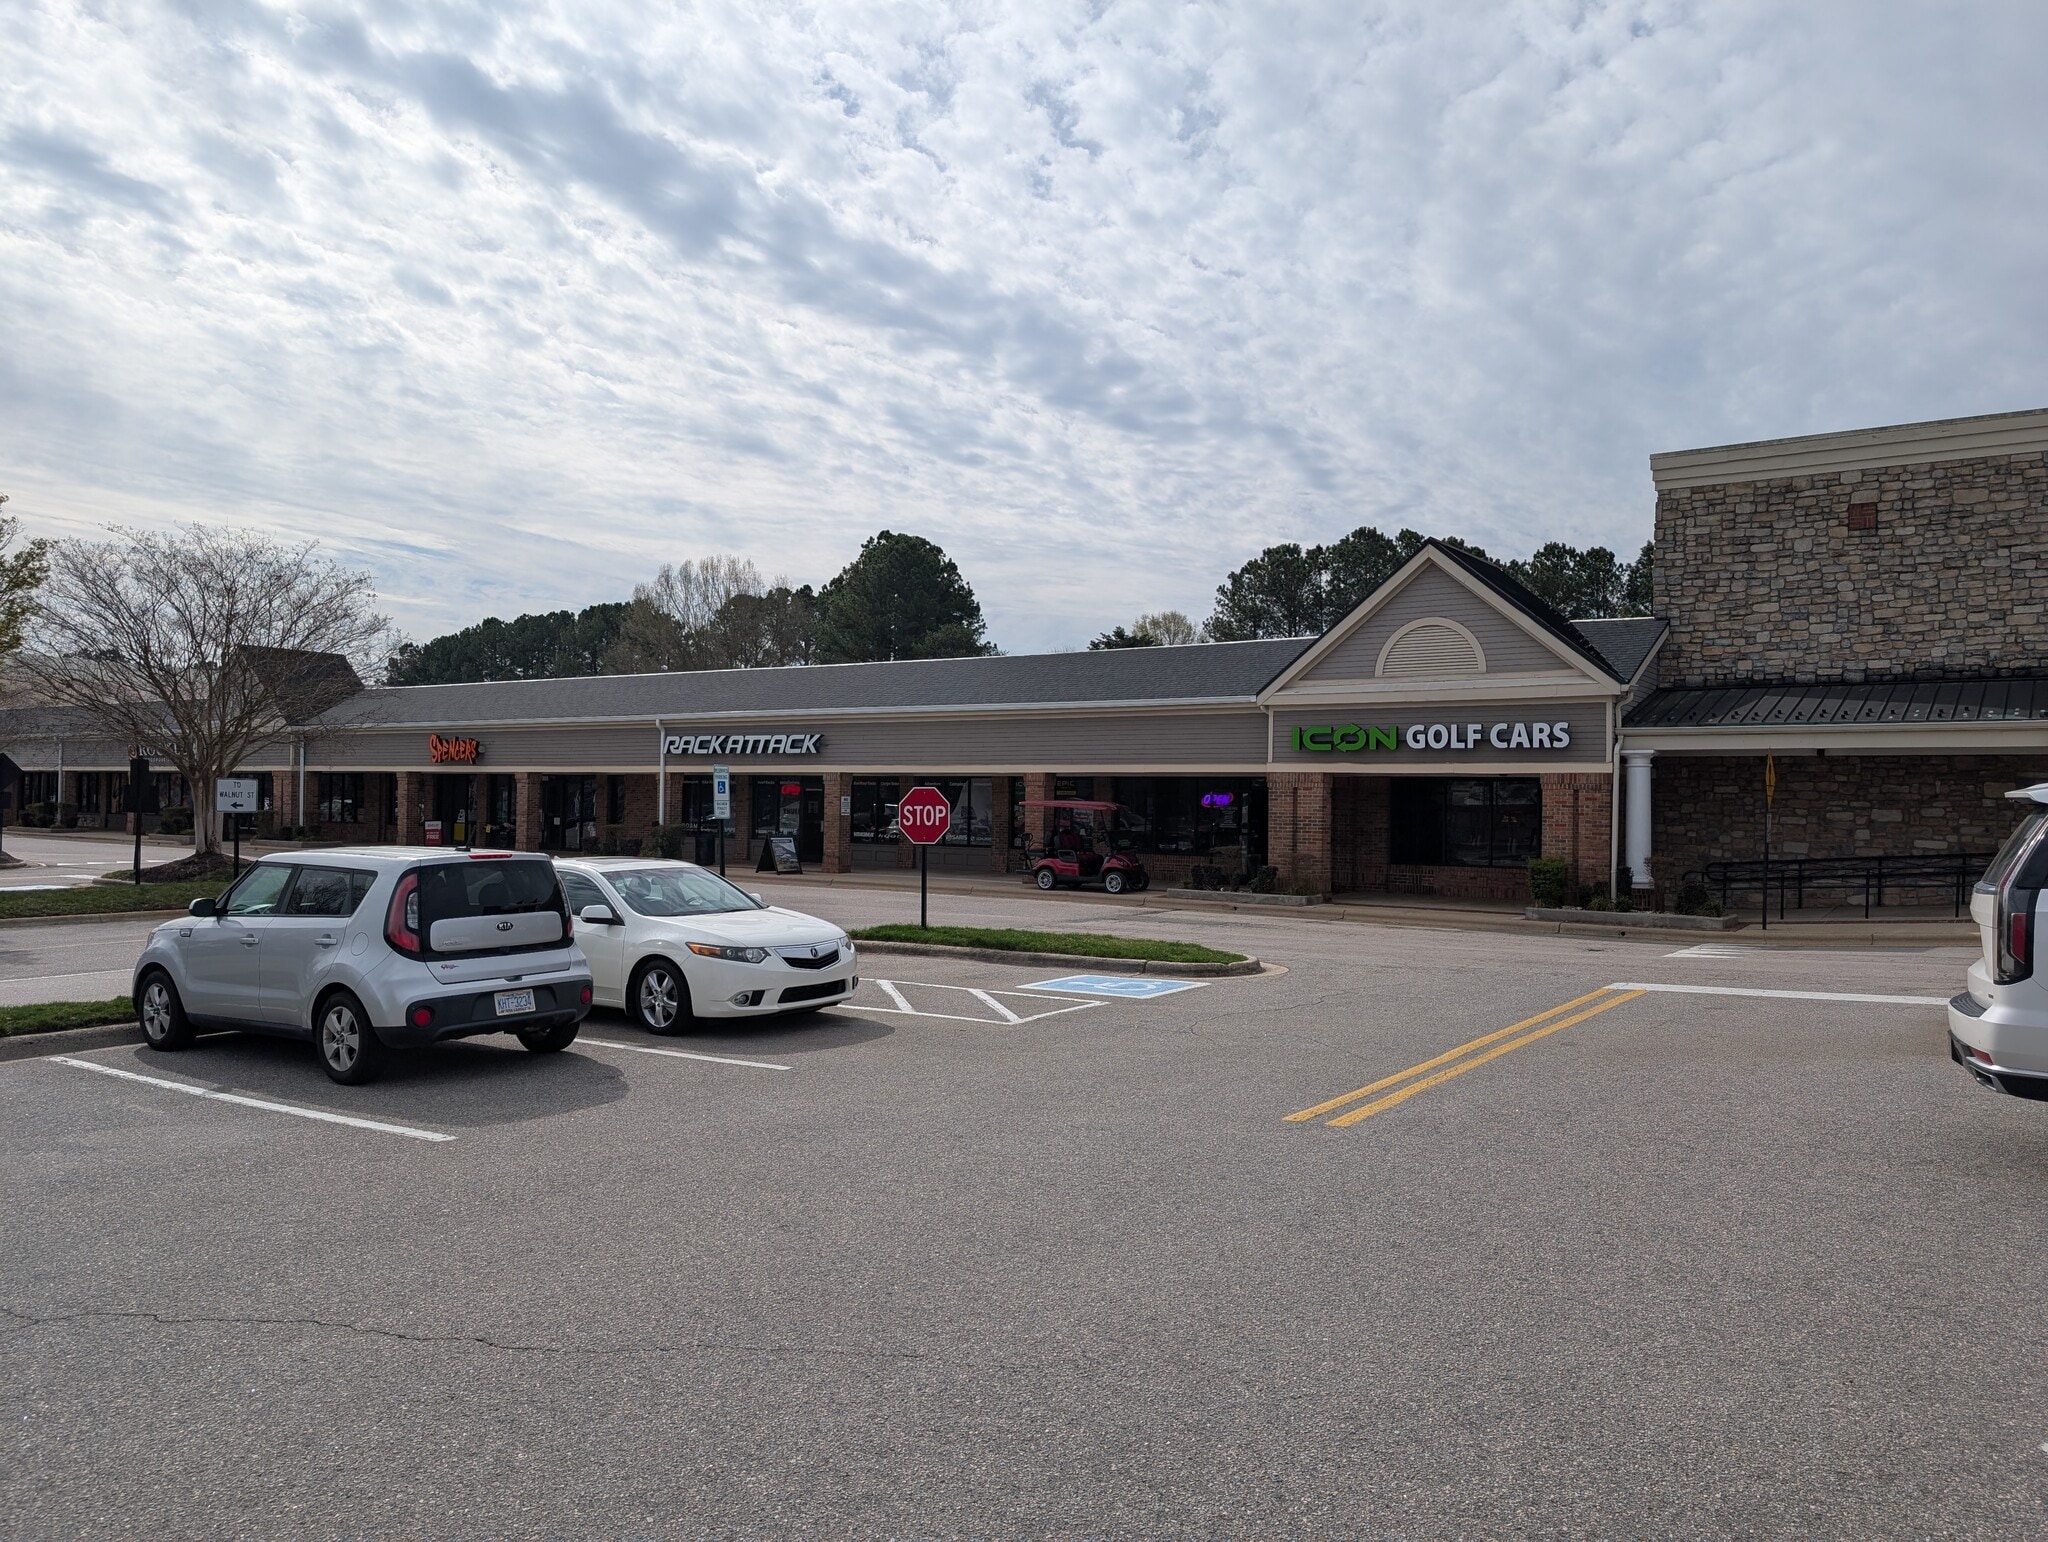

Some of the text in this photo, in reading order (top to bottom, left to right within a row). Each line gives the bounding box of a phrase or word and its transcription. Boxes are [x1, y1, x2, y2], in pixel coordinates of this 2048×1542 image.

[1291, 722, 1570, 752] ICON GOLF CARS
[903, 805, 946, 826] STOP
